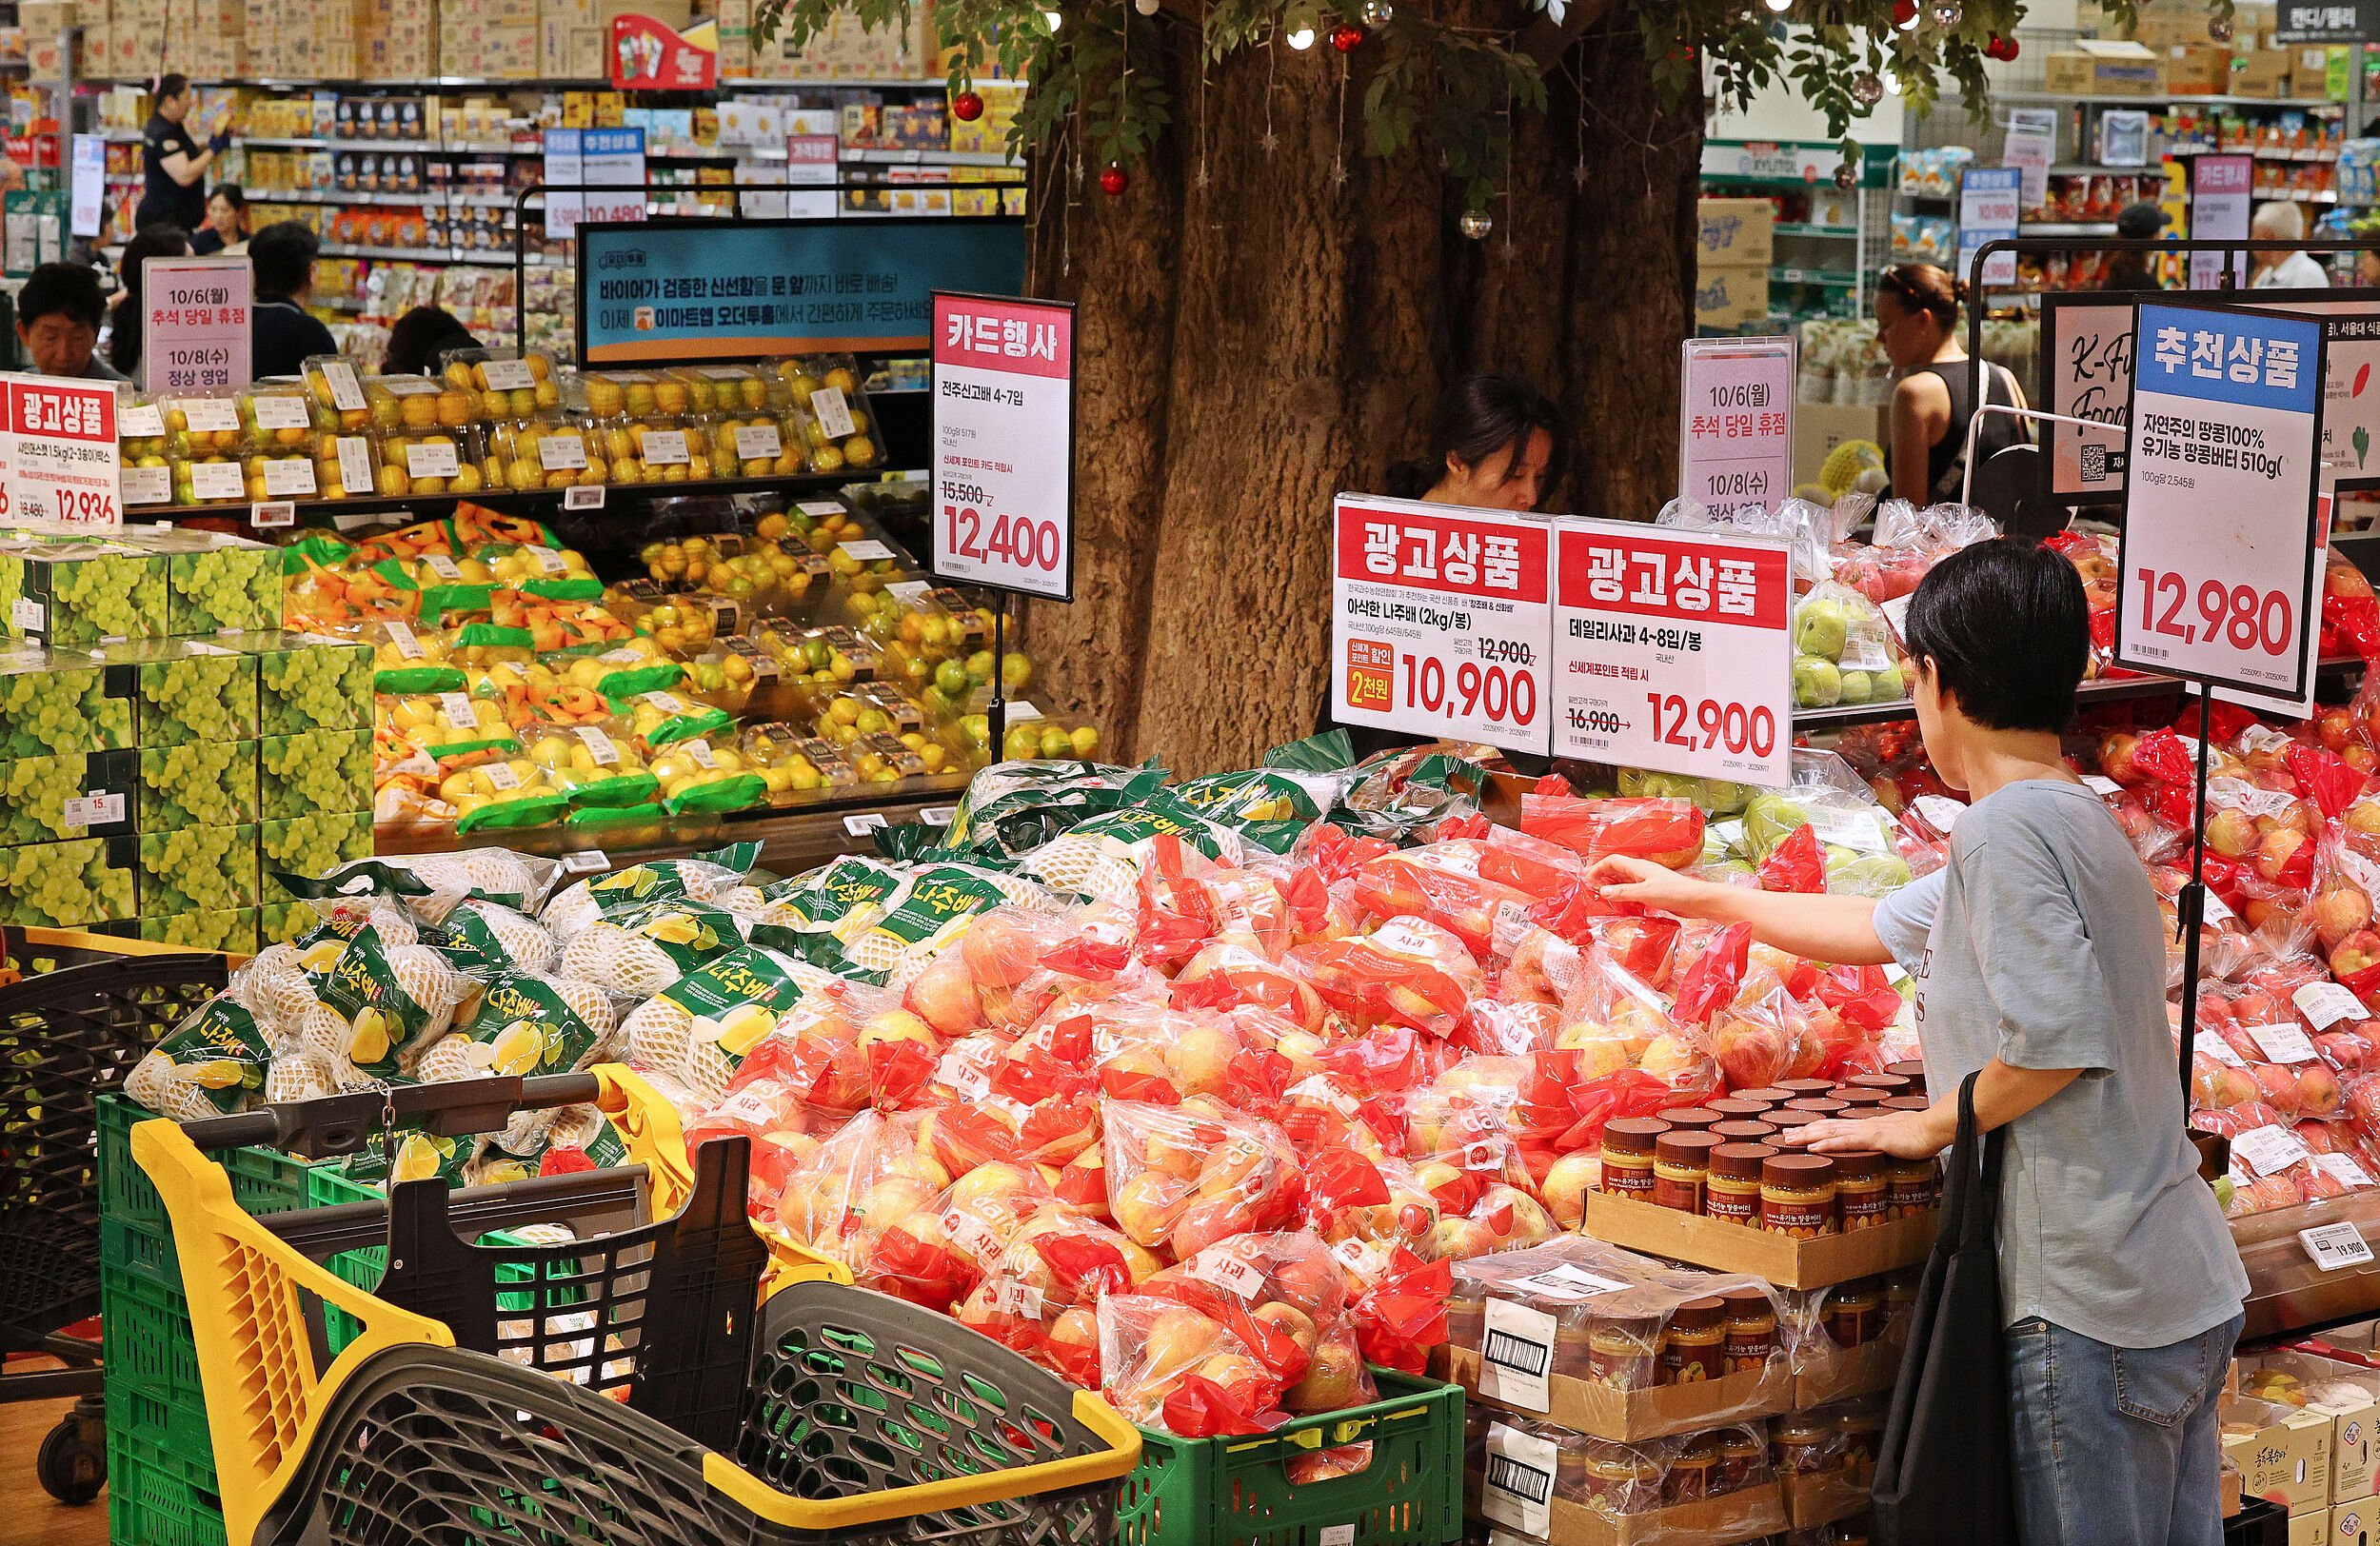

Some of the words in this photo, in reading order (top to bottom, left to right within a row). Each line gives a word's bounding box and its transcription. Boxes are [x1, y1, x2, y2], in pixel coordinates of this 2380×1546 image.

[169, 287, 228, 305] 10/6(월)
[600, 278, 660, 299] 바이어가
[663, 278, 708, 298] 검증한
[711, 277, 769, 298] 신선함을
[772, 276, 785, 297] 문
[788, 274, 831, 296] 앞까지
[835, 274, 863, 294] 바로
[866, 272, 898, 293] 배송!
[152, 309, 180, 326] 추석
[185, 308, 212, 326] 당일
[219, 307, 245, 324] 휴점
[600, 309, 629, 329] 이제
[656, 306, 713, 327] 이마트앱
[808, 301, 863, 324] 간편하게
[947, 313, 1058, 361] 카드행사
[2341, 321, 2366, 336] 서울대
[169, 348, 228, 365] 10/8(수)
[2154, 327, 2299, 388] 추천상품
[168, 369, 196, 386] 정상
[201, 368, 228, 386] 영업
[942, 381, 991, 402] 전주신고배
[994, 387, 1023, 406] 4~7입
[1710, 383, 1771, 407] 10/6(월)
[23, 393, 102, 435] 광고상품
[1691, 415, 1719, 439] 추석
[1725, 413, 1753, 438] 당일
[1758, 412, 1786, 436] 휴점
[942, 425, 961, 437] 100g당
[962, 427, 976, 439] 517원
[942, 437, 958, 447] 국내산
[2143, 413, 2195, 439] 자연주의
[2198, 421, 2265, 448] 땅콩100%
[943, 454, 961, 465] 신세계
[962, 457, 980, 469] 포인트
[981, 459, 994, 471] 카드
[2142, 436, 2181, 460] 유기농
[2184, 442, 2237, 469] 땅콩버터
[1707, 470, 1768, 496] 10/8(수)
[2141, 470, 2167, 486] 100g당
[2167, 474, 2195, 488] 2,545원
[942, 480, 983, 505] 15,500
[943, 505, 1061, 571] 12,400
[1363, 522, 1520, 590] 광고상품
[1587, 546, 1756, 616] 광고상품
[1429, 593, 1440, 605] 국산
[2138, 567, 2292, 656] 12,980
[1347, 598, 1380, 619] 아삭한
[1383, 602, 1417, 623] 나주배
[1418, 605, 1472, 631] (2kg/봉)
[1385, 624, 1421, 640] 645원/545원
[1569, 618, 1636, 644] 데일리사과
[1639, 626, 1701, 652] 4~8입/봉
[1351, 642, 1369, 653] 신세계
[1351, 652, 1369, 664] 포인트
[1371, 647, 1391, 665] 할인
[1478, 637, 1531, 665] 12,900
[1656, 653, 1675, 664] 국내산
[1569, 660, 1618, 679] 신세계포인트
[1621, 666, 1637, 681] 적립
[1640, 669, 1649, 682] 시
[1351, 671, 1388, 704] 2천원
[1402, 654, 1536, 726] 10,900
[1569, 707, 1618, 734] 16,900
[1647, 692, 1775, 758] 12,900
[912, 884, 978, 915] 나주배
[1397, 934, 1426, 949] 사과
[339, 954, 378, 1001] 나주배
[707, 964, 773, 1001] 나주배
[487, 986, 536, 1020] 나주배
[1504, 1022, 1523, 1044] 사과
[957, 1064, 981, 1083] 사과
[738, 1097, 762, 1112] 사과
[1622, 1178, 1639, 1186] 유기농
[1779, 1214, 1797, 1222] 유기농
[1798, 1214, 1821, 1222] 땅콩버터
[975, 1234, 1002, 1262] 사과
[2336, 1242, 2365, 1257] 19,900
[1214, 1259, 1245, 1280] 사과
